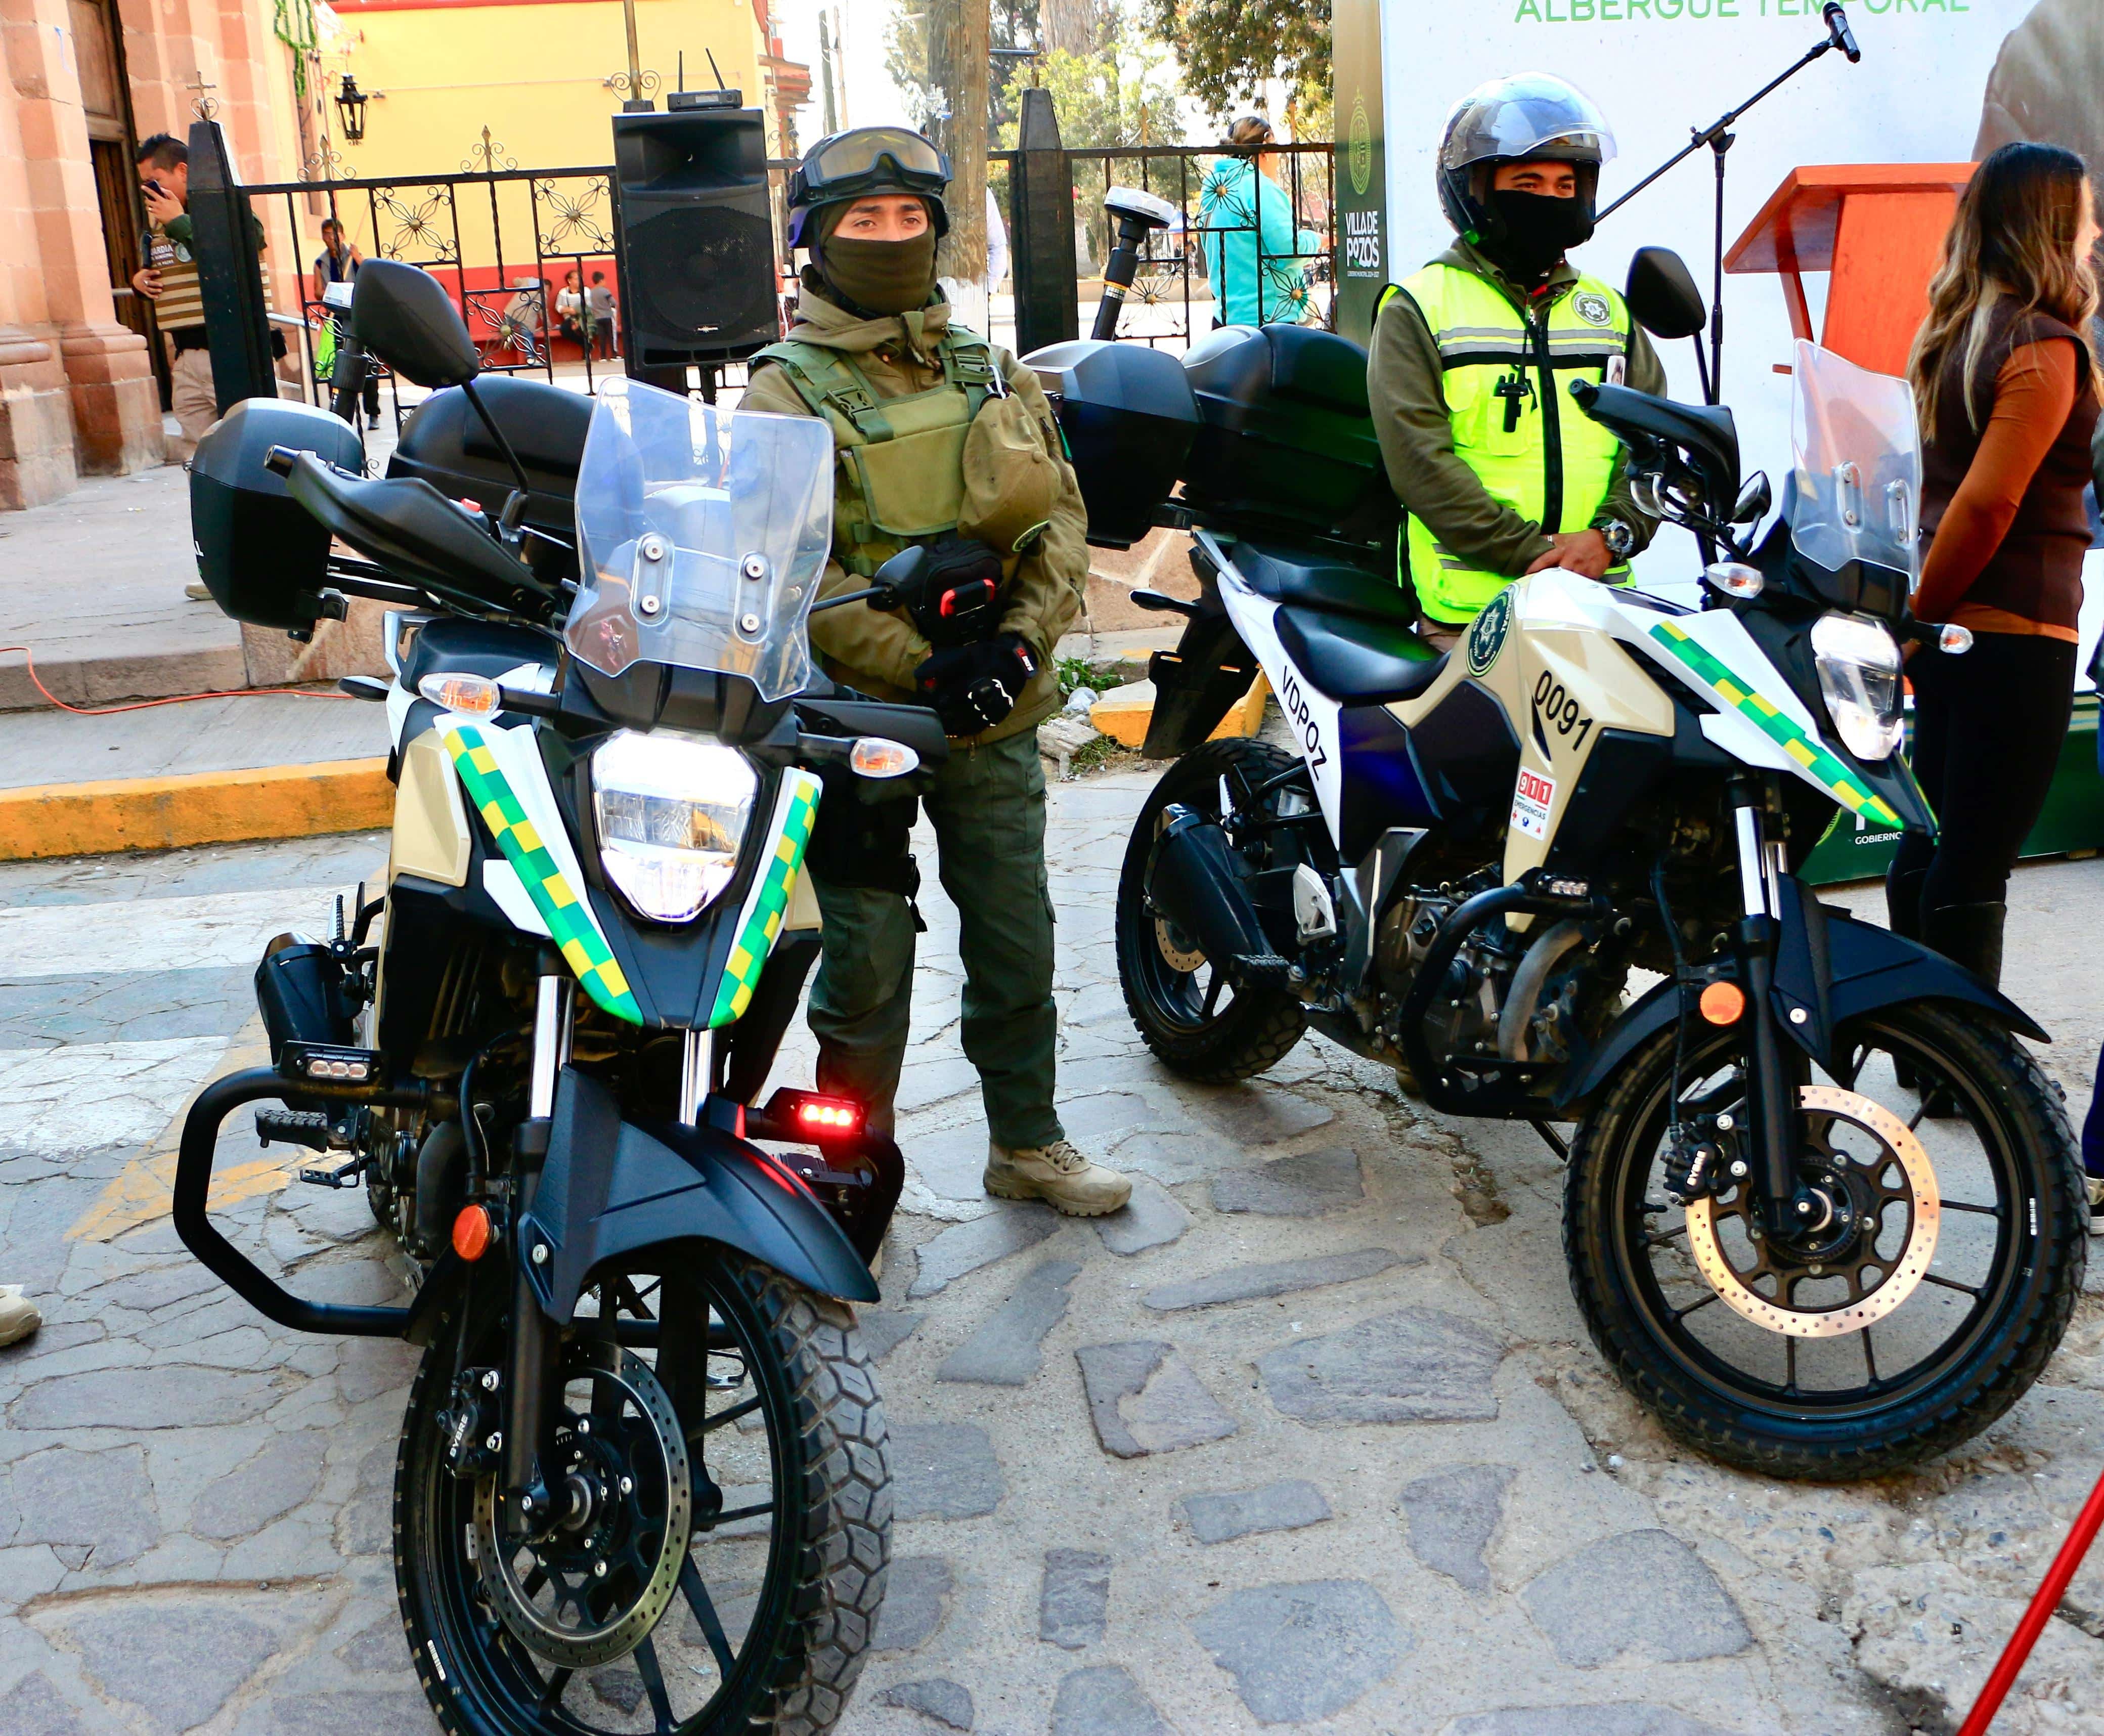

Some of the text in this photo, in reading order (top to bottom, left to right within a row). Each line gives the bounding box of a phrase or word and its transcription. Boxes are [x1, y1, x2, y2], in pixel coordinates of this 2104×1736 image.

[1514, 0, 1739, 23] ALBERGUE
[1345, 210, 1378, 235] VILLA DE
[1346, 236, 1379, 268] POZOS
[1283, 665, 1327, 782] VDPOZ
[1535, 670, 1593, 751] 0091
[1519, 775, 1550, 803] 911
[1514, 799, 1546, 820] EMERGENCIAS
